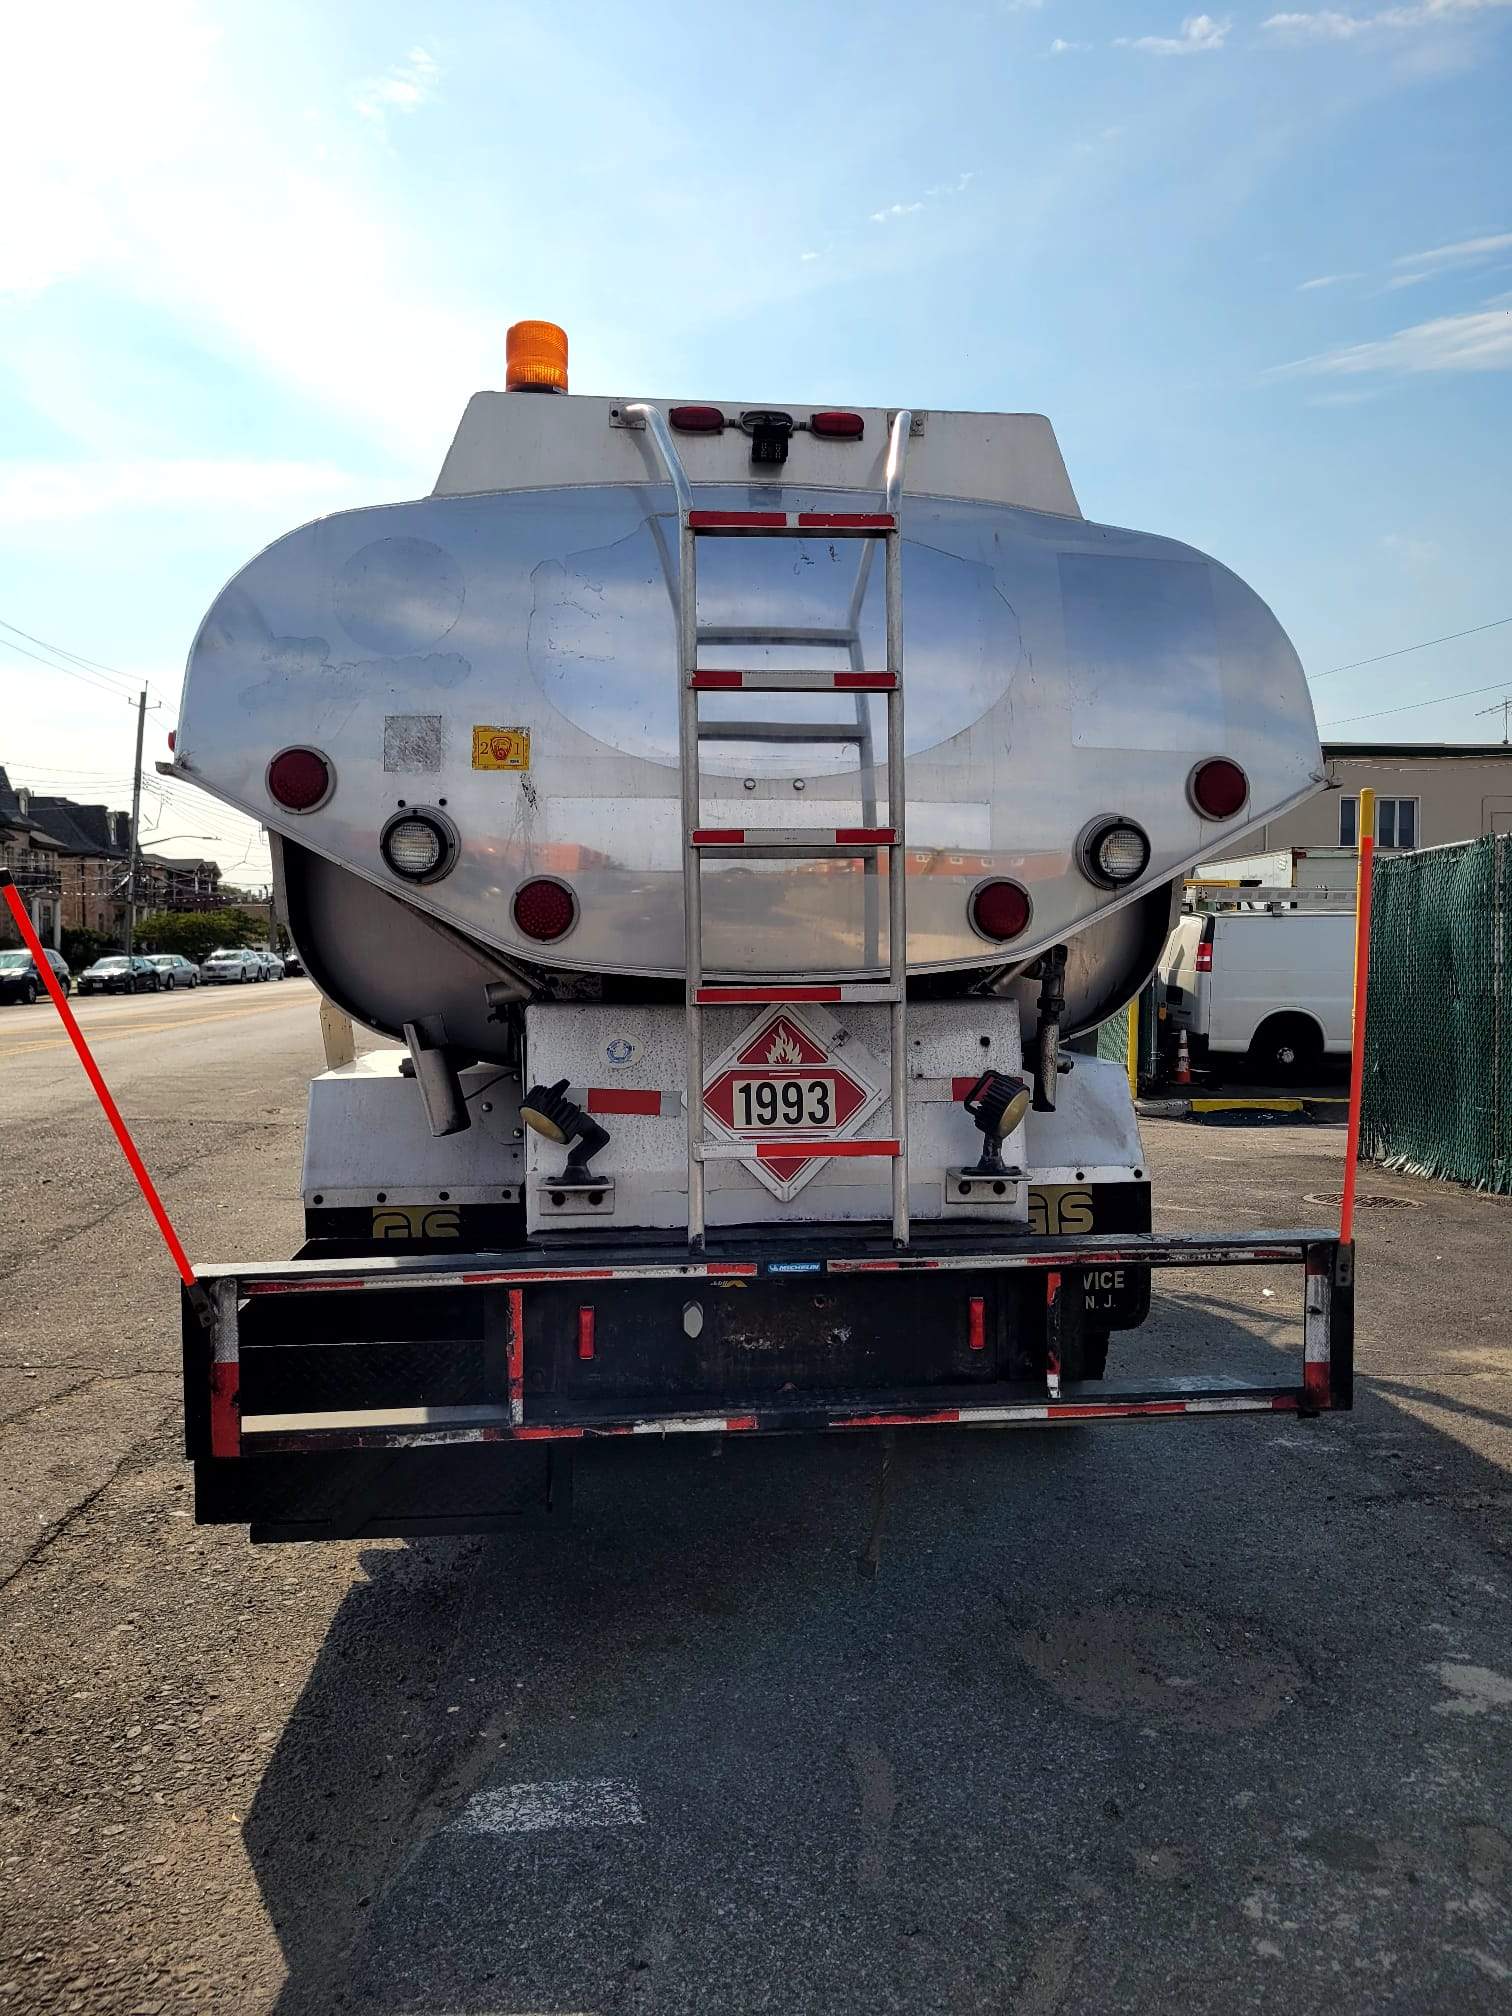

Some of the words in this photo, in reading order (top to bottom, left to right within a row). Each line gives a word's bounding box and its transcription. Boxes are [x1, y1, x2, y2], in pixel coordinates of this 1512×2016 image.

[738, 1080, 831, 1126] 1993
[777, 1264, 820, 1273] MICHELIN
[1083, 1270, 1126, 1290] VICE
